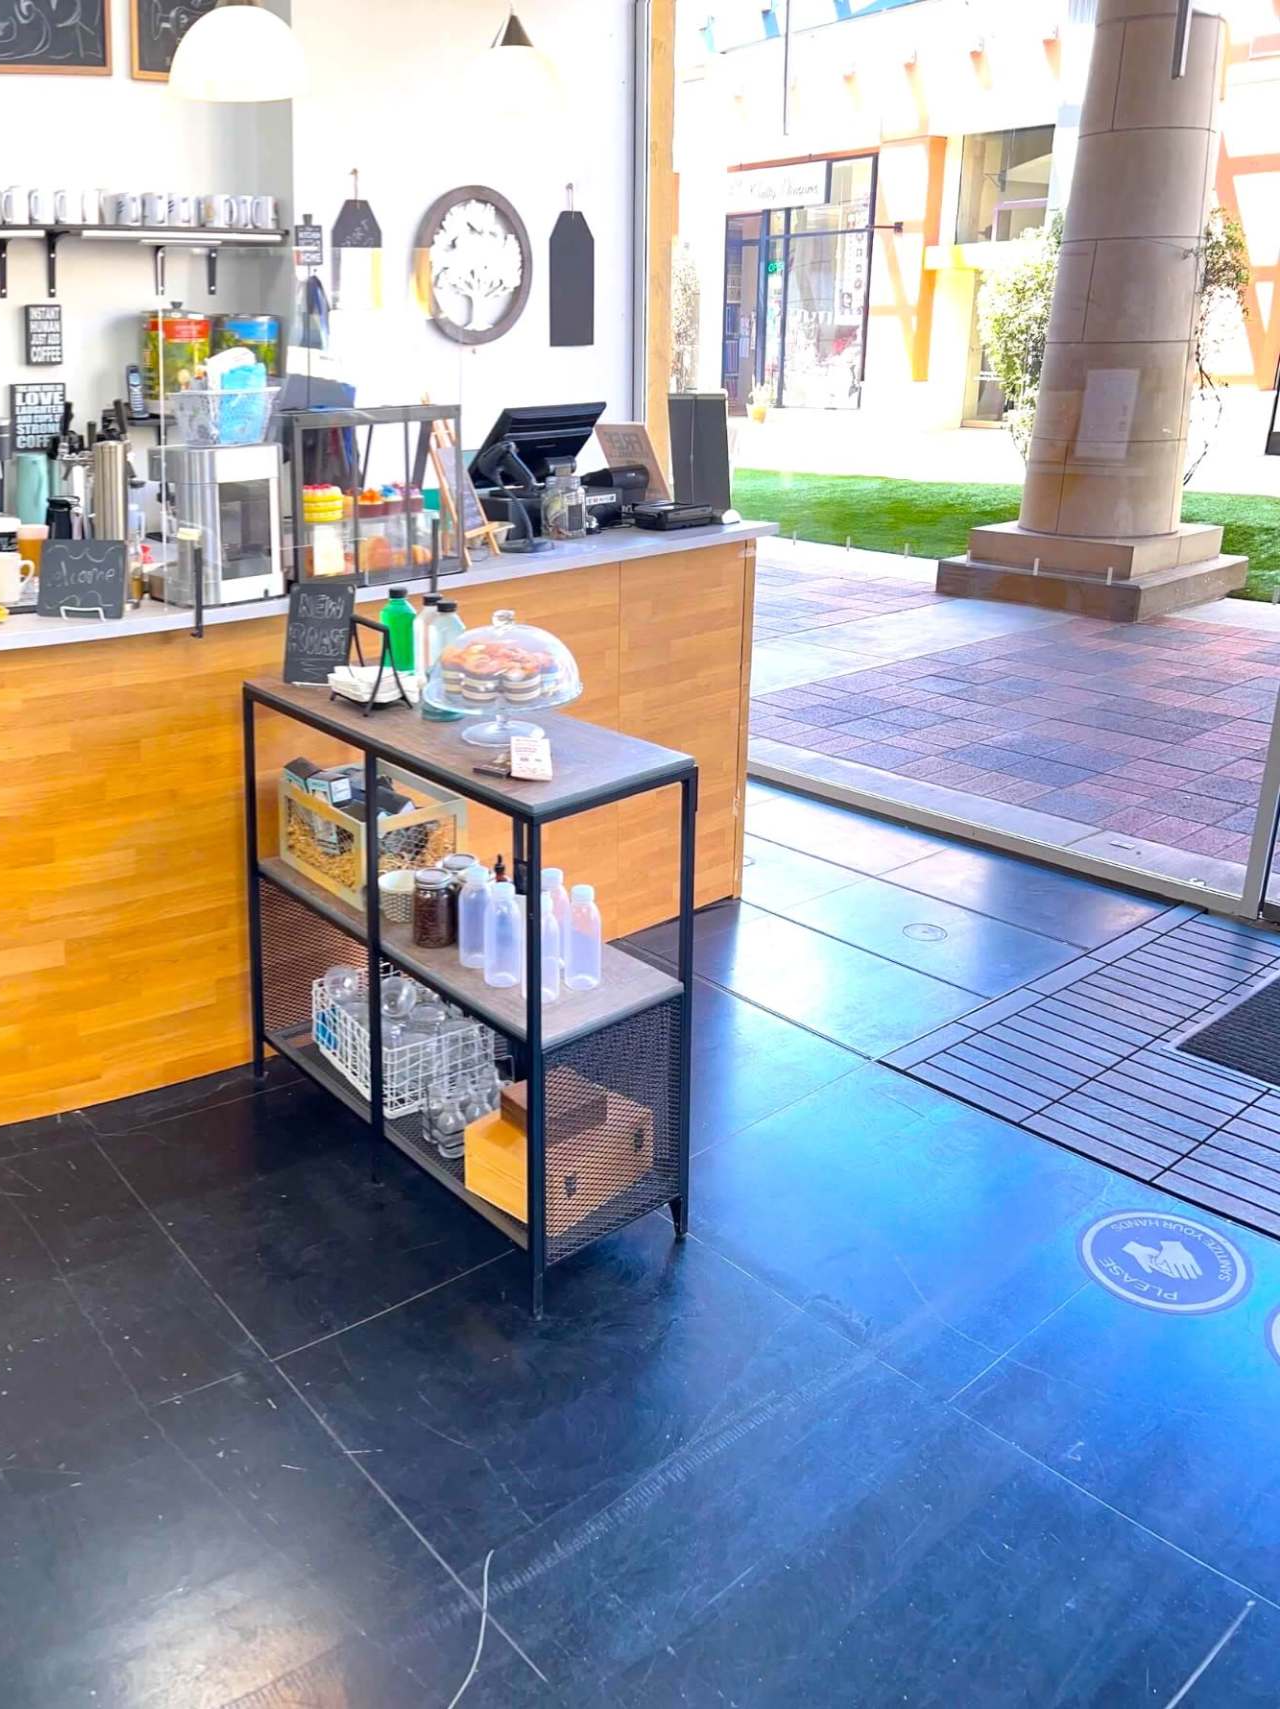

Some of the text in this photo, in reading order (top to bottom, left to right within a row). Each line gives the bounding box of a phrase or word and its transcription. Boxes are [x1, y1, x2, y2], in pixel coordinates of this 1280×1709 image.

[30, 346, 63, 362] COFFEE
[15, 391, 65, 406] LOVE
[16, 435, 52, 449] COFF
[1109, 1217, 1234, 1282] SANITIZE YOUR HANDS
[1098, 1256, 1179, 1301] PLEASE
